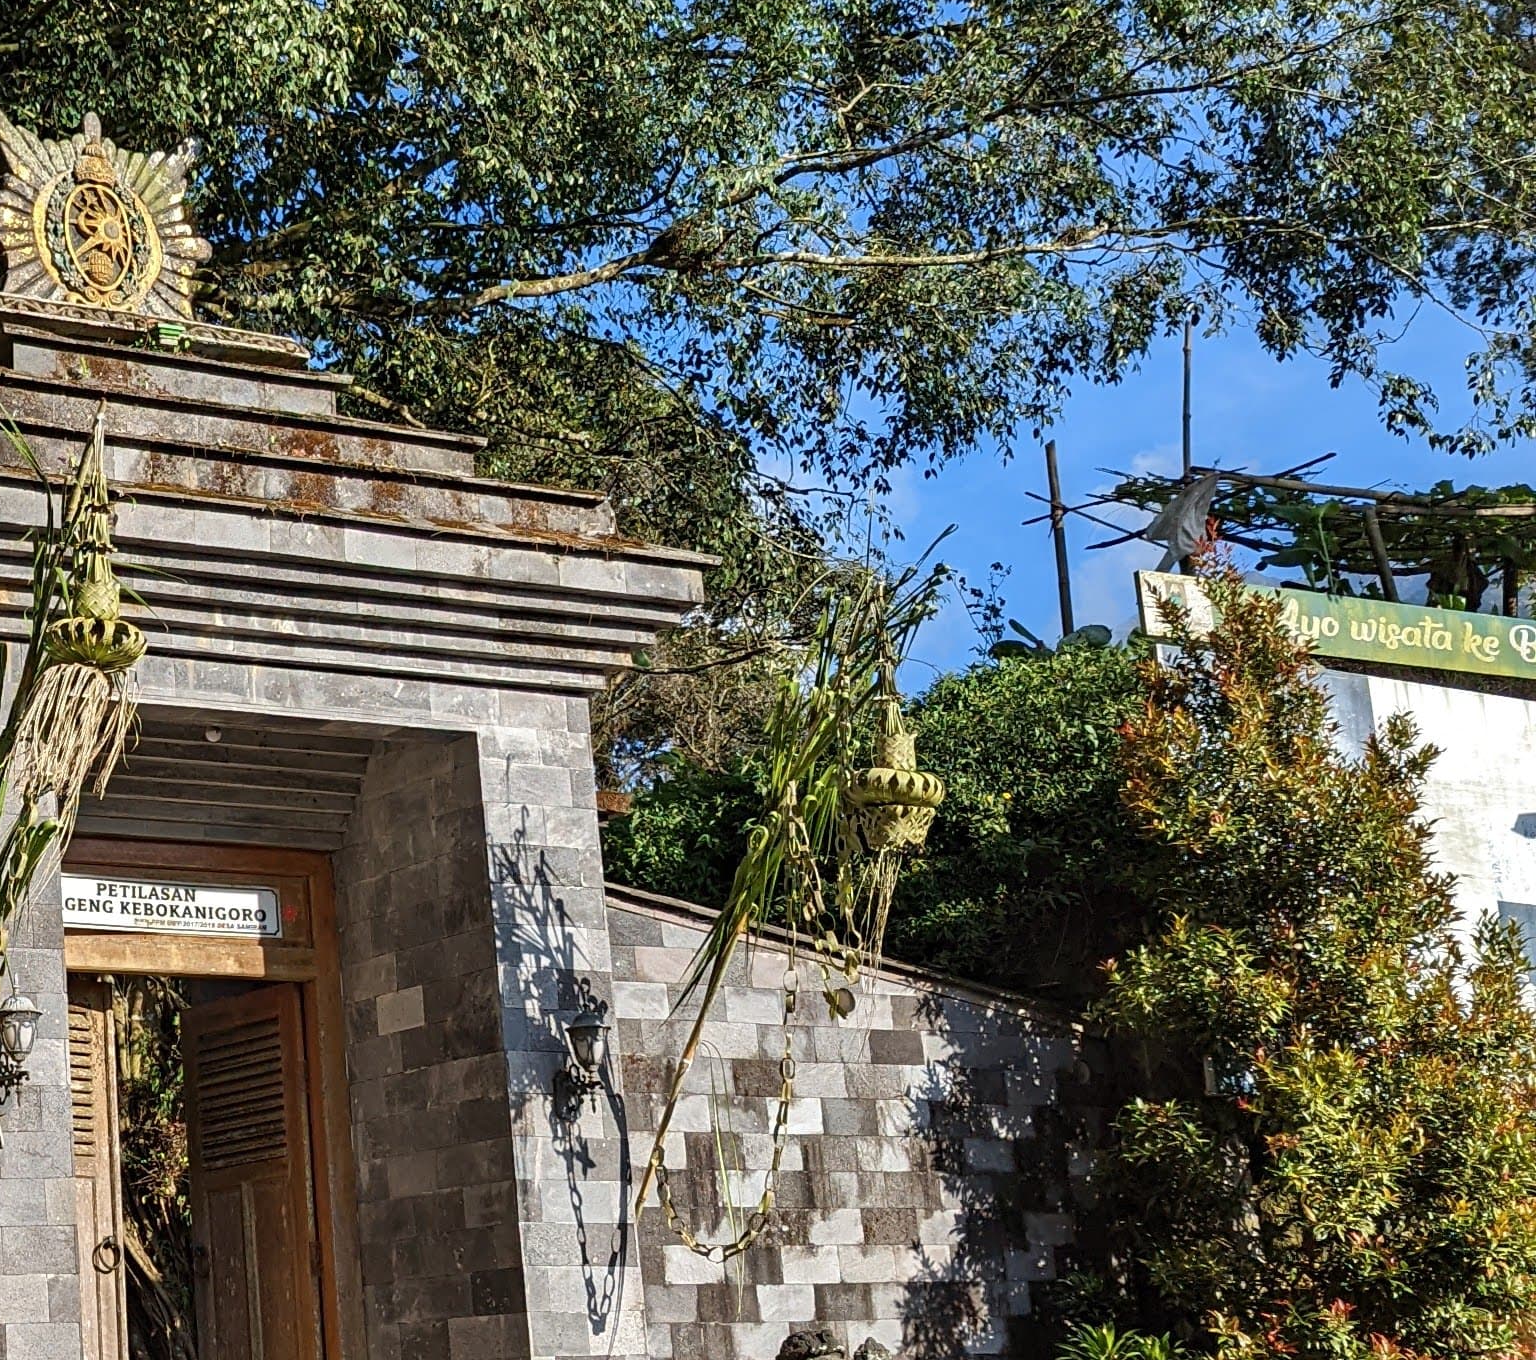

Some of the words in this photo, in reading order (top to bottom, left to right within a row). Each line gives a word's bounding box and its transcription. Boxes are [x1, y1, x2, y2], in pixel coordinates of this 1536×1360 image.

[1350, 615, 1453, 650] wisata
[1463, 622, 1500, 663] ke
[96, 882, 196, 902] PETILASAN
[62, 897, 114, 914] GENG
[120, 901, 267, 922] KEBOKANIGORO
